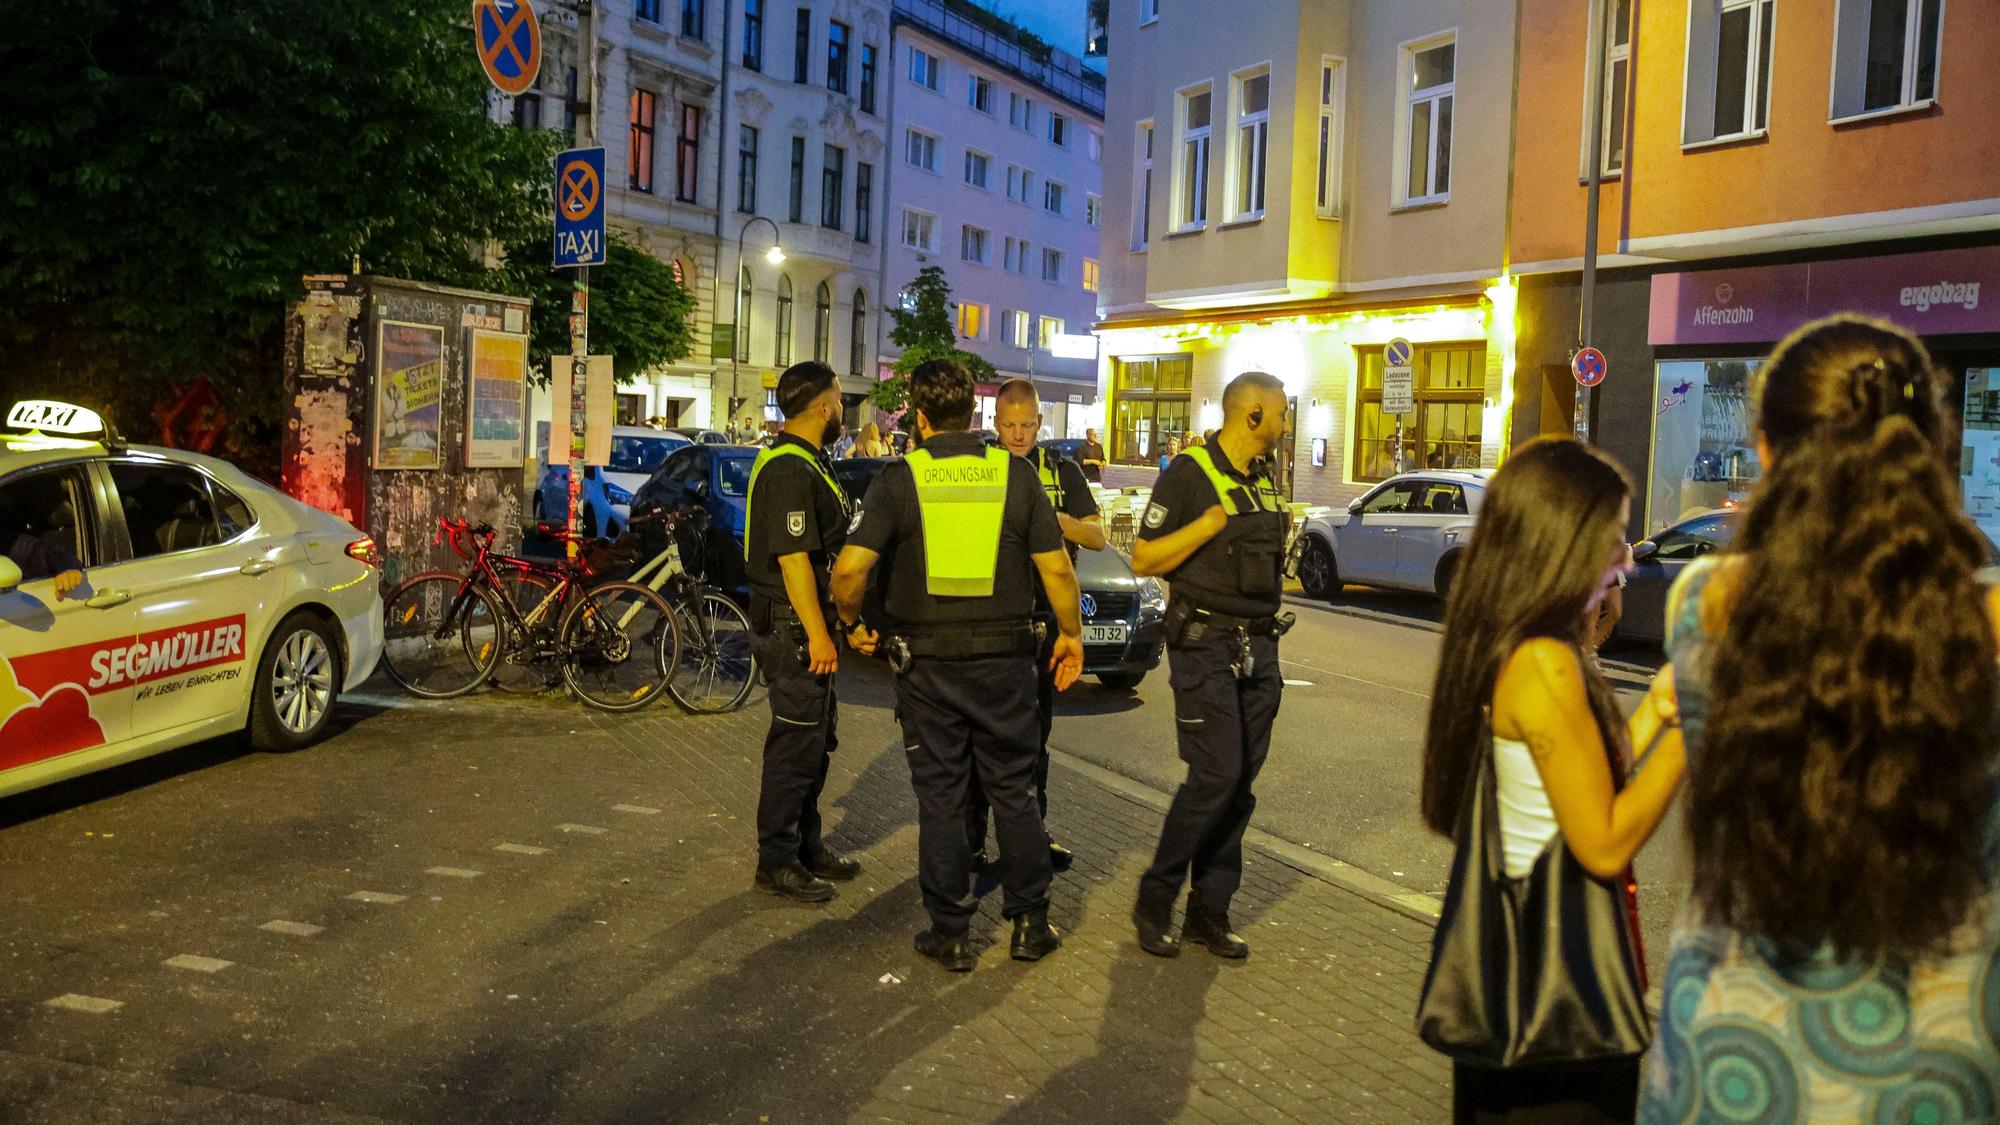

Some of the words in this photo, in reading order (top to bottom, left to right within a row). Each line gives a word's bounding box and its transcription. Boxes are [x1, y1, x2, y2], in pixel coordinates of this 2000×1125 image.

[558, 229, 599, 256] TAXI
[1900, 281, 1980, 312] ergobag
[1693, 305, 1753, 326] Affenzahn
[13, 404, 78, 427] TAXI
[924, 466, 998, 483] ORDNUNGSAMT
[1089, 627, 1105, 641] JD
[1107, 627, 1122, 641] 32
[89, 623, 242, 688] SEGMÜLLER
[136, 685, 153, 700] WIR
[155, 680, 185, 697] LEBEN
[186, 667, 242, 689] EINRICHTEN
